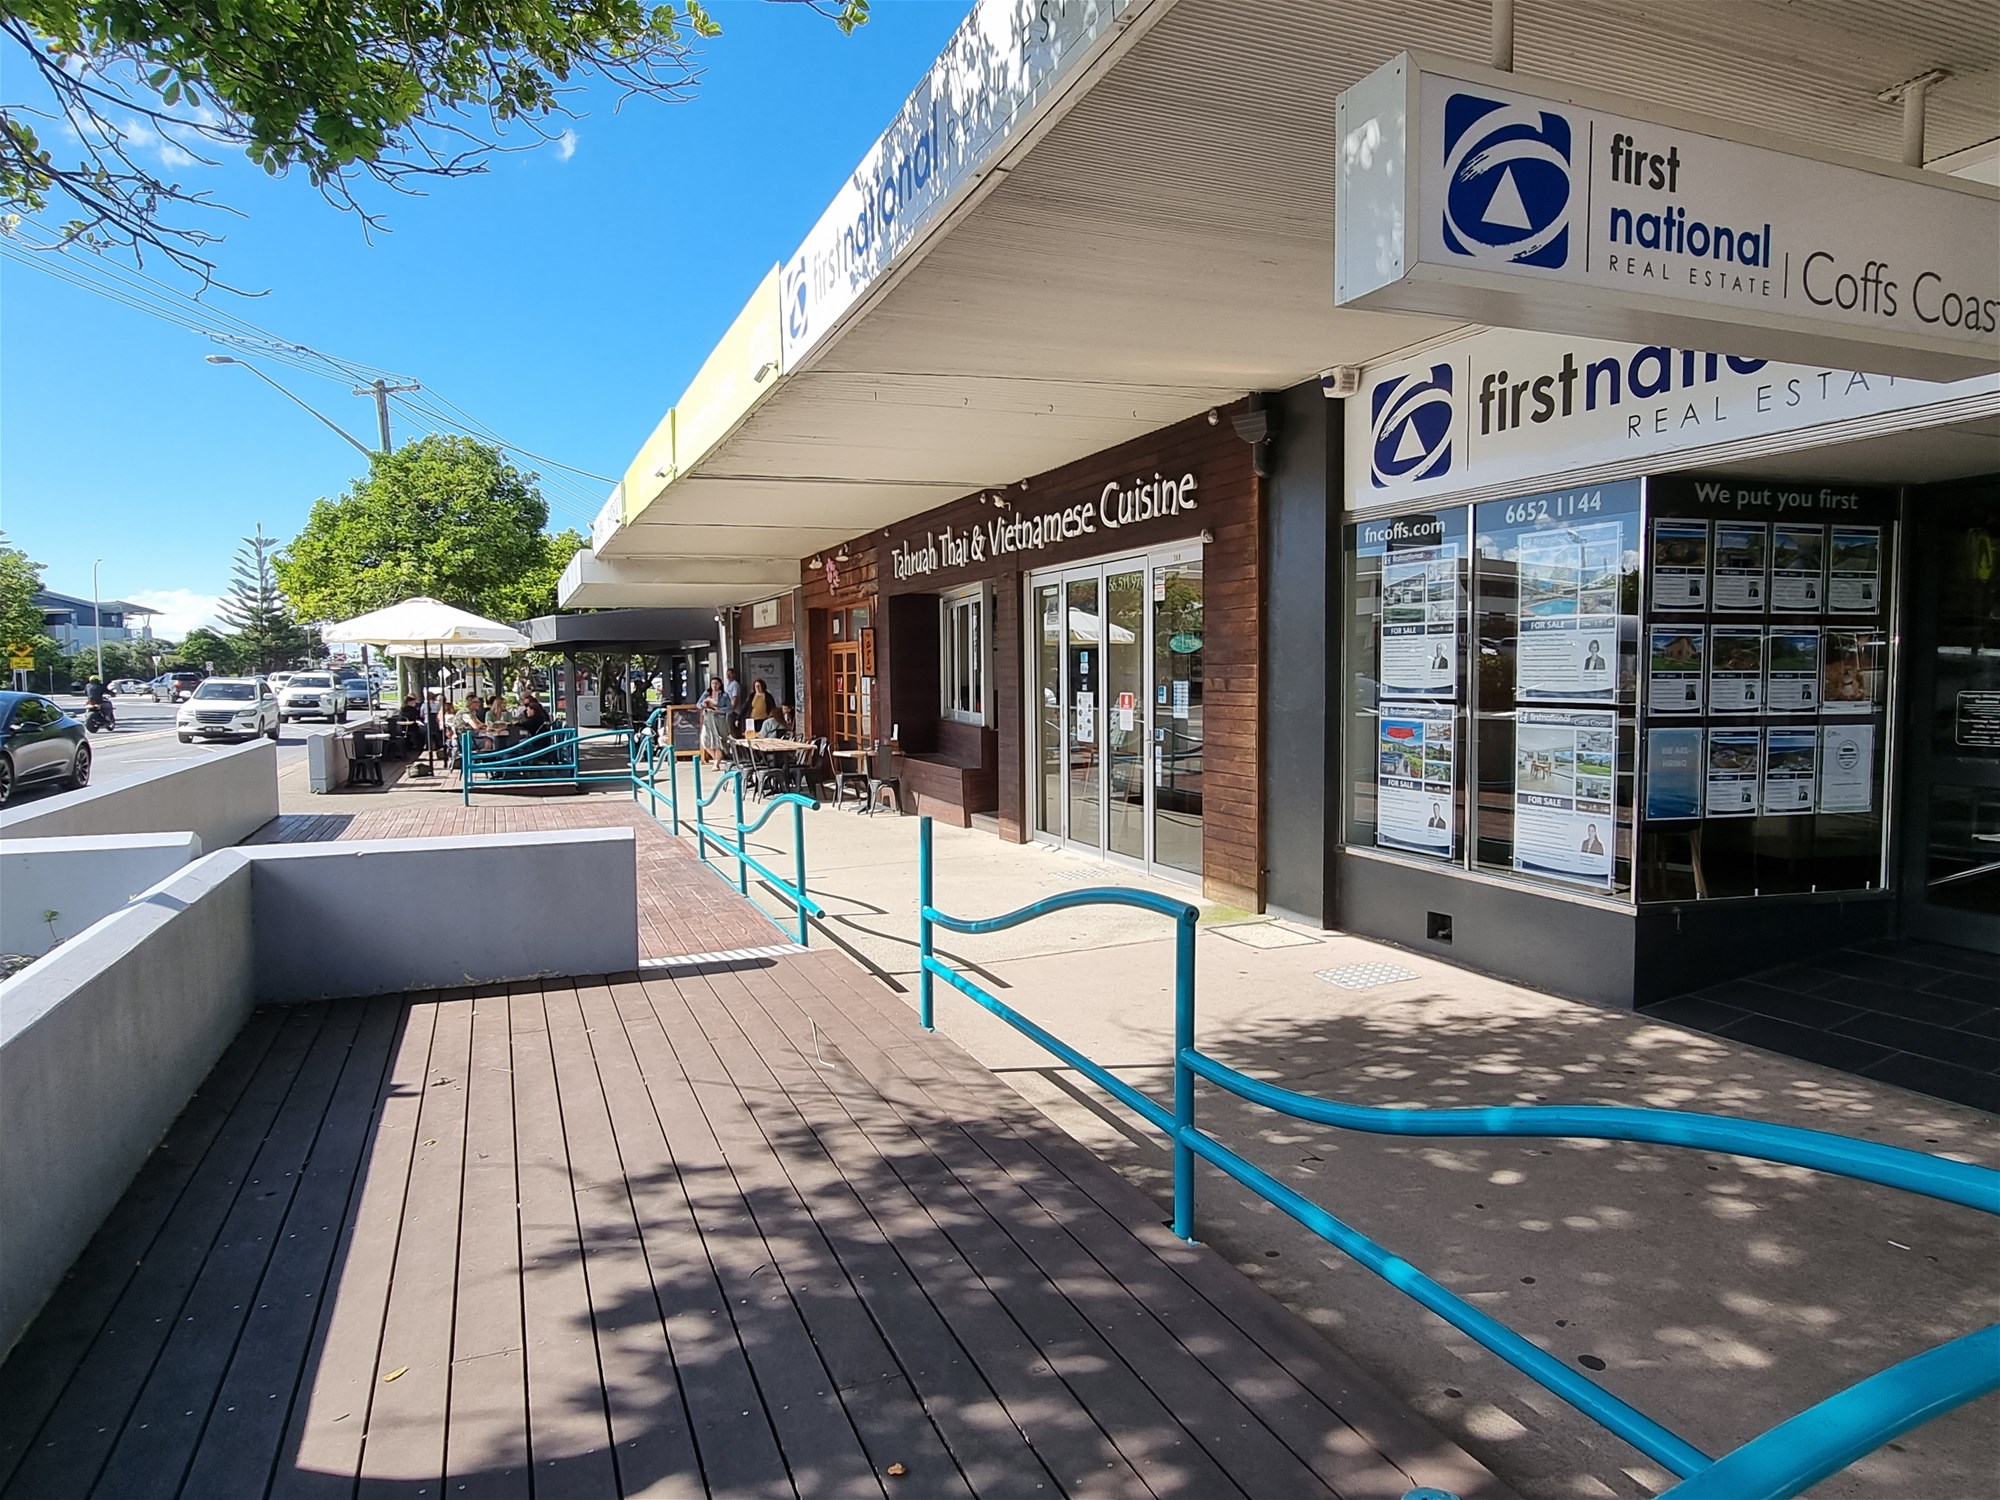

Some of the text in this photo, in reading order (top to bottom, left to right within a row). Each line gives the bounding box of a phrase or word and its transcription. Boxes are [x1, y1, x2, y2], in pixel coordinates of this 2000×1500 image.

[1610, 133, 1680, 192] first
[1610, 205, 1771, 268] national
[1609, 254, 1770, 296] REAL ESTATE
[1802, 251, 2000, 333] Coffs Coas
[1627, 396, 1727, 440] REAL
[1505, 490, 1602, 525] 6652 1144
[1694, 482, 1858, 512] We put you first
[891, 472, 1198, 580] Tahruah Thai & Vietnamese Cuisine
[1364, 517, 1446, 543] fncoffs.com
[1390, 626, 1416, 635] FOR SALE
[1530, 620, 1565, 629] FOR SALE
[1387, 778, 1414, 789] FOR SALE
[1527, 795, 1562, 807] FOR SALE
